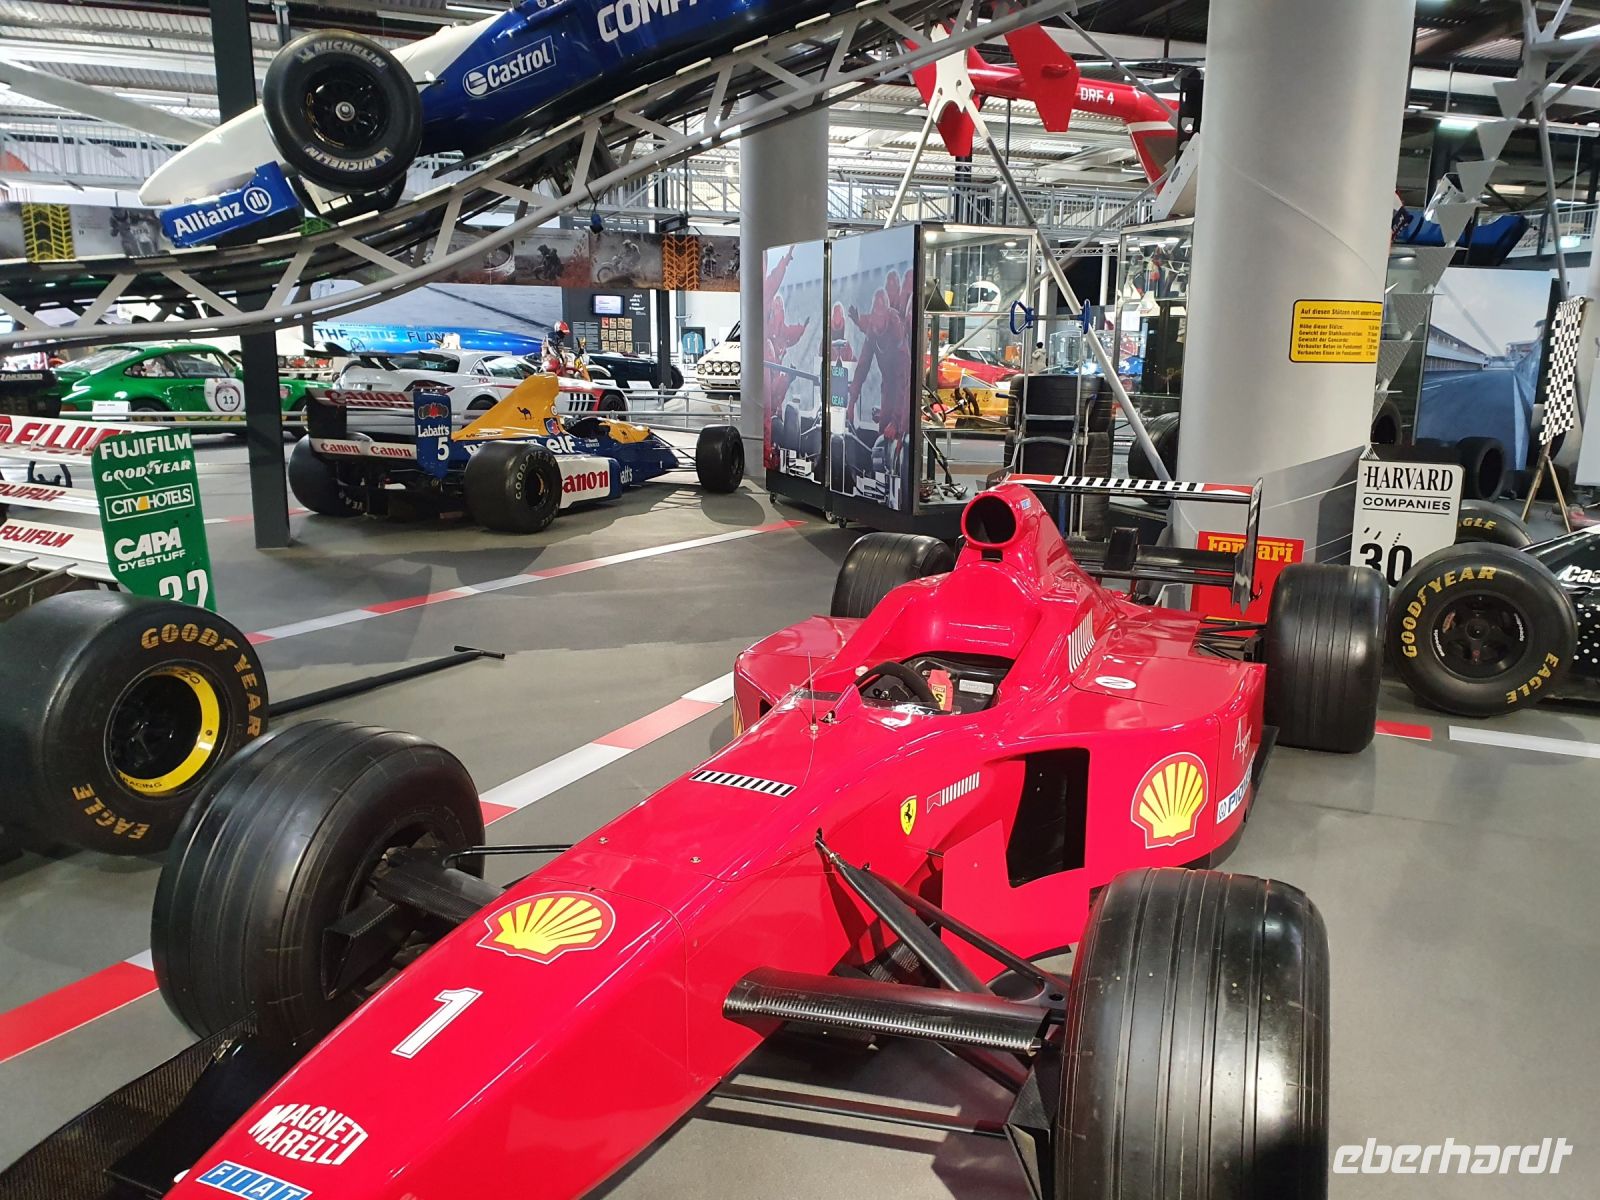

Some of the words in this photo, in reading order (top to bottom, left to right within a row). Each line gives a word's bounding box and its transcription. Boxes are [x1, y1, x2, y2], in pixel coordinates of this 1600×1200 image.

[314, 40, 387, 69] MICHELIN
[487, 43, 552, 88] Castrol
[1080, 87, 1104, 103] DRF
[1107, 91, 1115, 105] 4
[305, 146, 378, 171] MICHELIN
[173, 201, 244, 238] Allianz
[315, 328, 348, 341] THE
[223, 395, 235, 405] 11
[417, 424, 450, 438] Labatt's
[100, 433, 192, 460] FUJIFILM
[320, 441, 361, 454] Canon
[371, 445, 412, 457] Canon
[437, 436, 450, 461] 5
[546, 437, 577, 454] elf
[562, 470, 609, 493] anon
[1365, 466, 1454, 492] HARVARD
[111, 497, 139, 515] CITY
[148, 488, 192, 508] HOTELS
[1363, 497, 1451, 511] COMPANIES
[0, 525, 74, 548] FUJIFILM
[114, 527, 182, 561] CAPA
[1208, 535, 1294, 562] Ferari
[118, 549, 186, 572] DYESTUFF
[1359, 543, 1413, 588] 30
[1401, 566, 1497, 659] GOODYEAR
[1506, 652, 1560, 704] EAGLE
[72, 783, 151, 840] EAGLE
[391, 987, 484, 1060] 1
[258, 1103, 369, 1146] MAGNETI
[248, 1119, 366, 1166] MARELLI
[210, 1165, 304, 1200] FIAT
